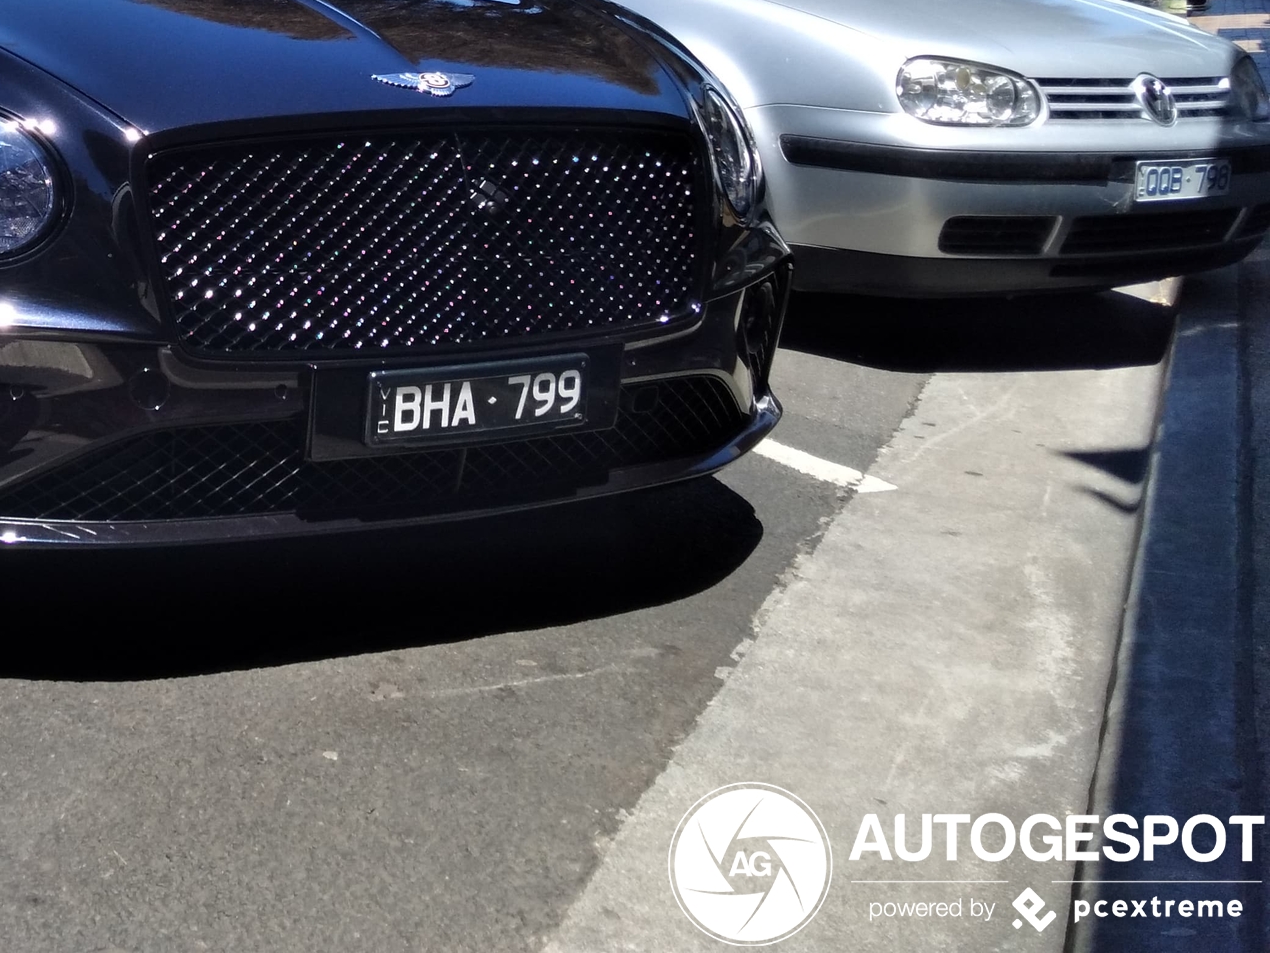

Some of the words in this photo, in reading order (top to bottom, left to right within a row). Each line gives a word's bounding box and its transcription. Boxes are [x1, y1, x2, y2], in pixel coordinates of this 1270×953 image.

[1195, 165, 1228, 193] 798
[377, 387, 391, 434] VIC
[394, 381, 476, 432] BHA
[508, 369, 581, 420] 799
